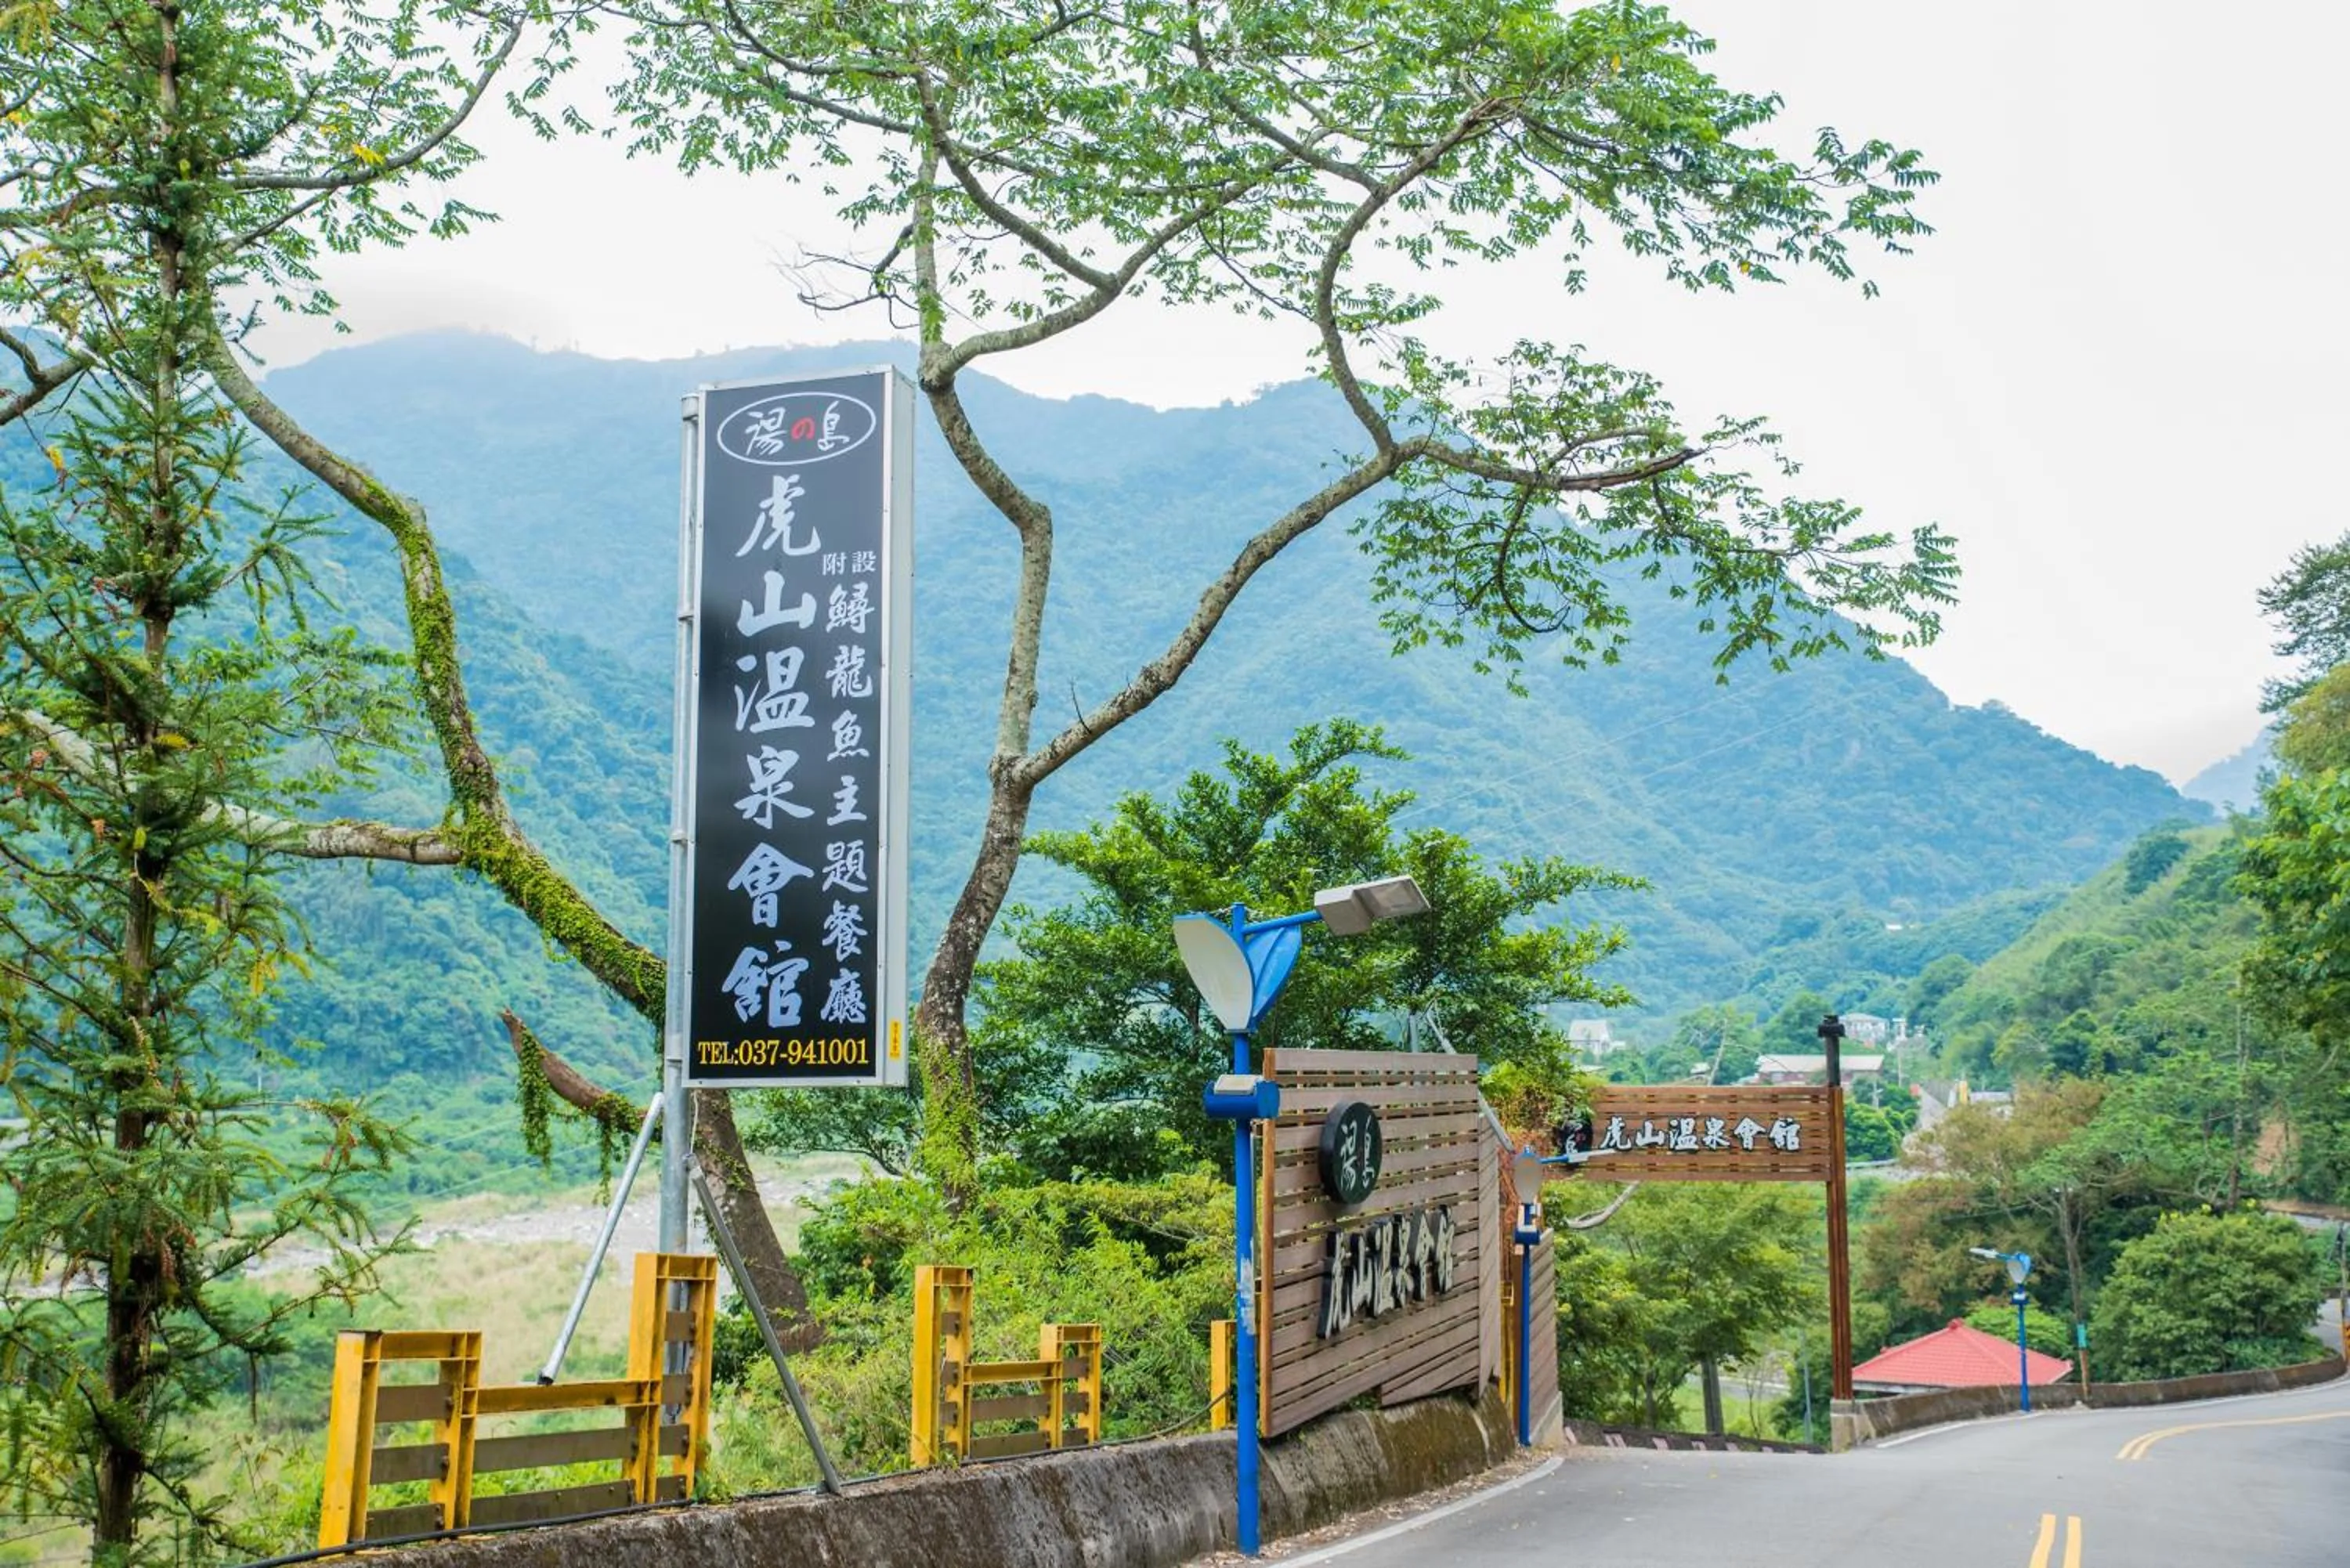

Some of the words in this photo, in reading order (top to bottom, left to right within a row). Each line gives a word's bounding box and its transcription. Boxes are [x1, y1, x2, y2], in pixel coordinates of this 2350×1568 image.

[745, 400, 850, 456] 湯の島
[822, 551, 876, 575] 附設
[820, 582, 875, 1024] 鱘龍魚主題餐廳
[698, 1039, 869, 1065] TEL:037-941001
